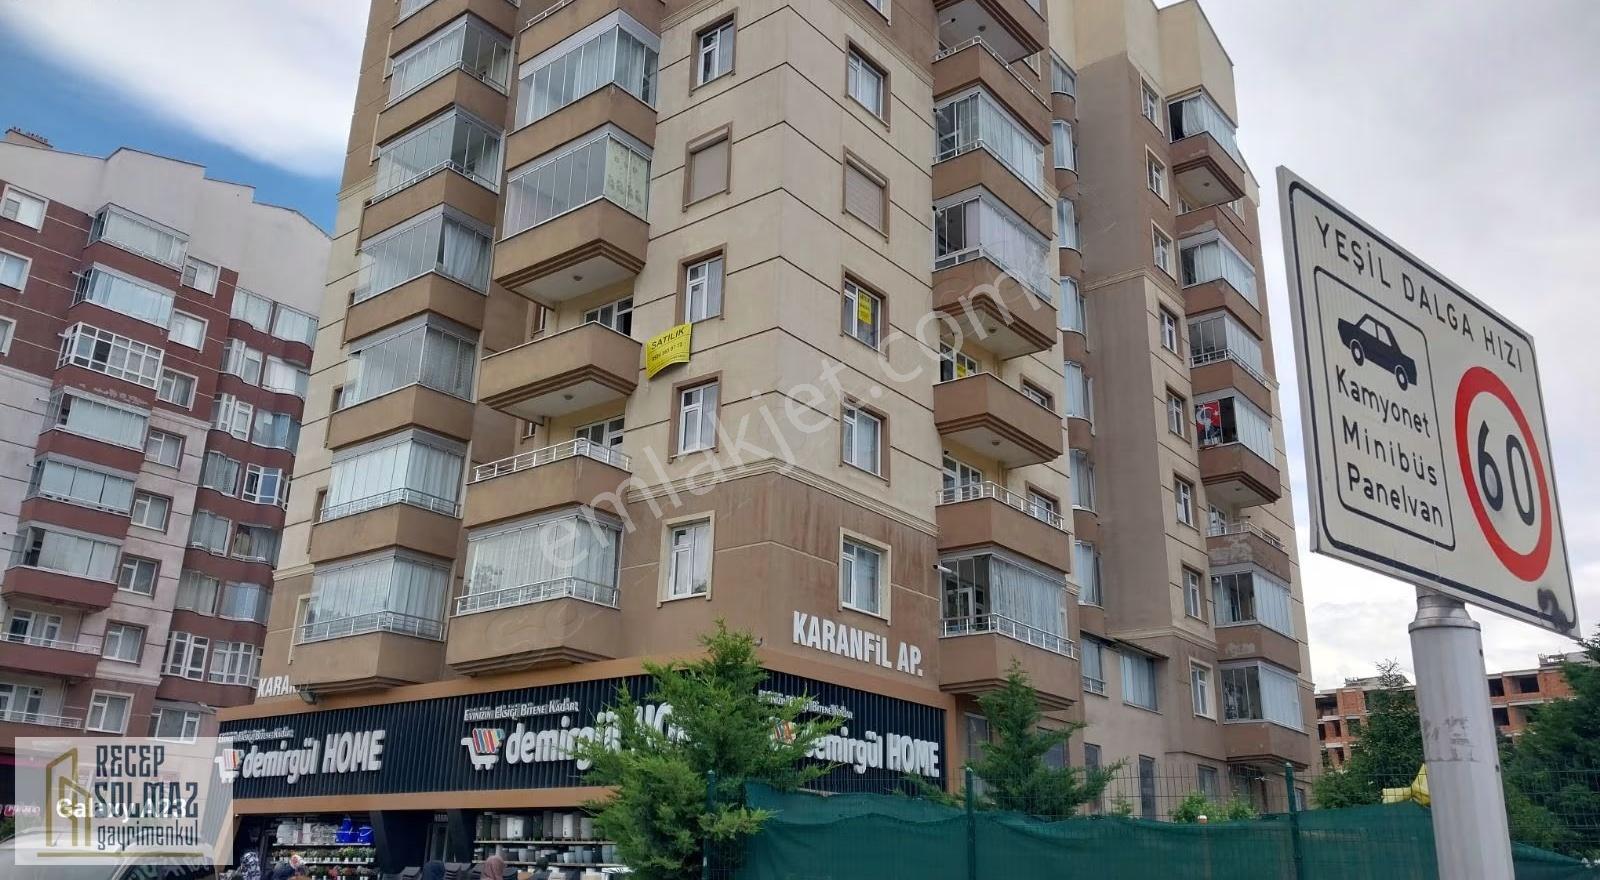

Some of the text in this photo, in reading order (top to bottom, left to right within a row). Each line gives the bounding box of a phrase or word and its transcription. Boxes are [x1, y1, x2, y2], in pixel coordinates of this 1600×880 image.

[1314, 215, 1523, 374] YEŞİL DALGA HIZI
[651, 326, 684, 350] SATILIK
[1335, 364, 1432, 438] Kamyonet
[1342, 415, 1438, 487] Minibüs
[1476, 419, 1535, 527] 60
[1346, 461, 1444, 529] Panelvan
[896, 641, 923, 677] AP.
[242, 730, 386, 784] demirgül HOME
[804, 726, 939, 777] emirgül HOME
